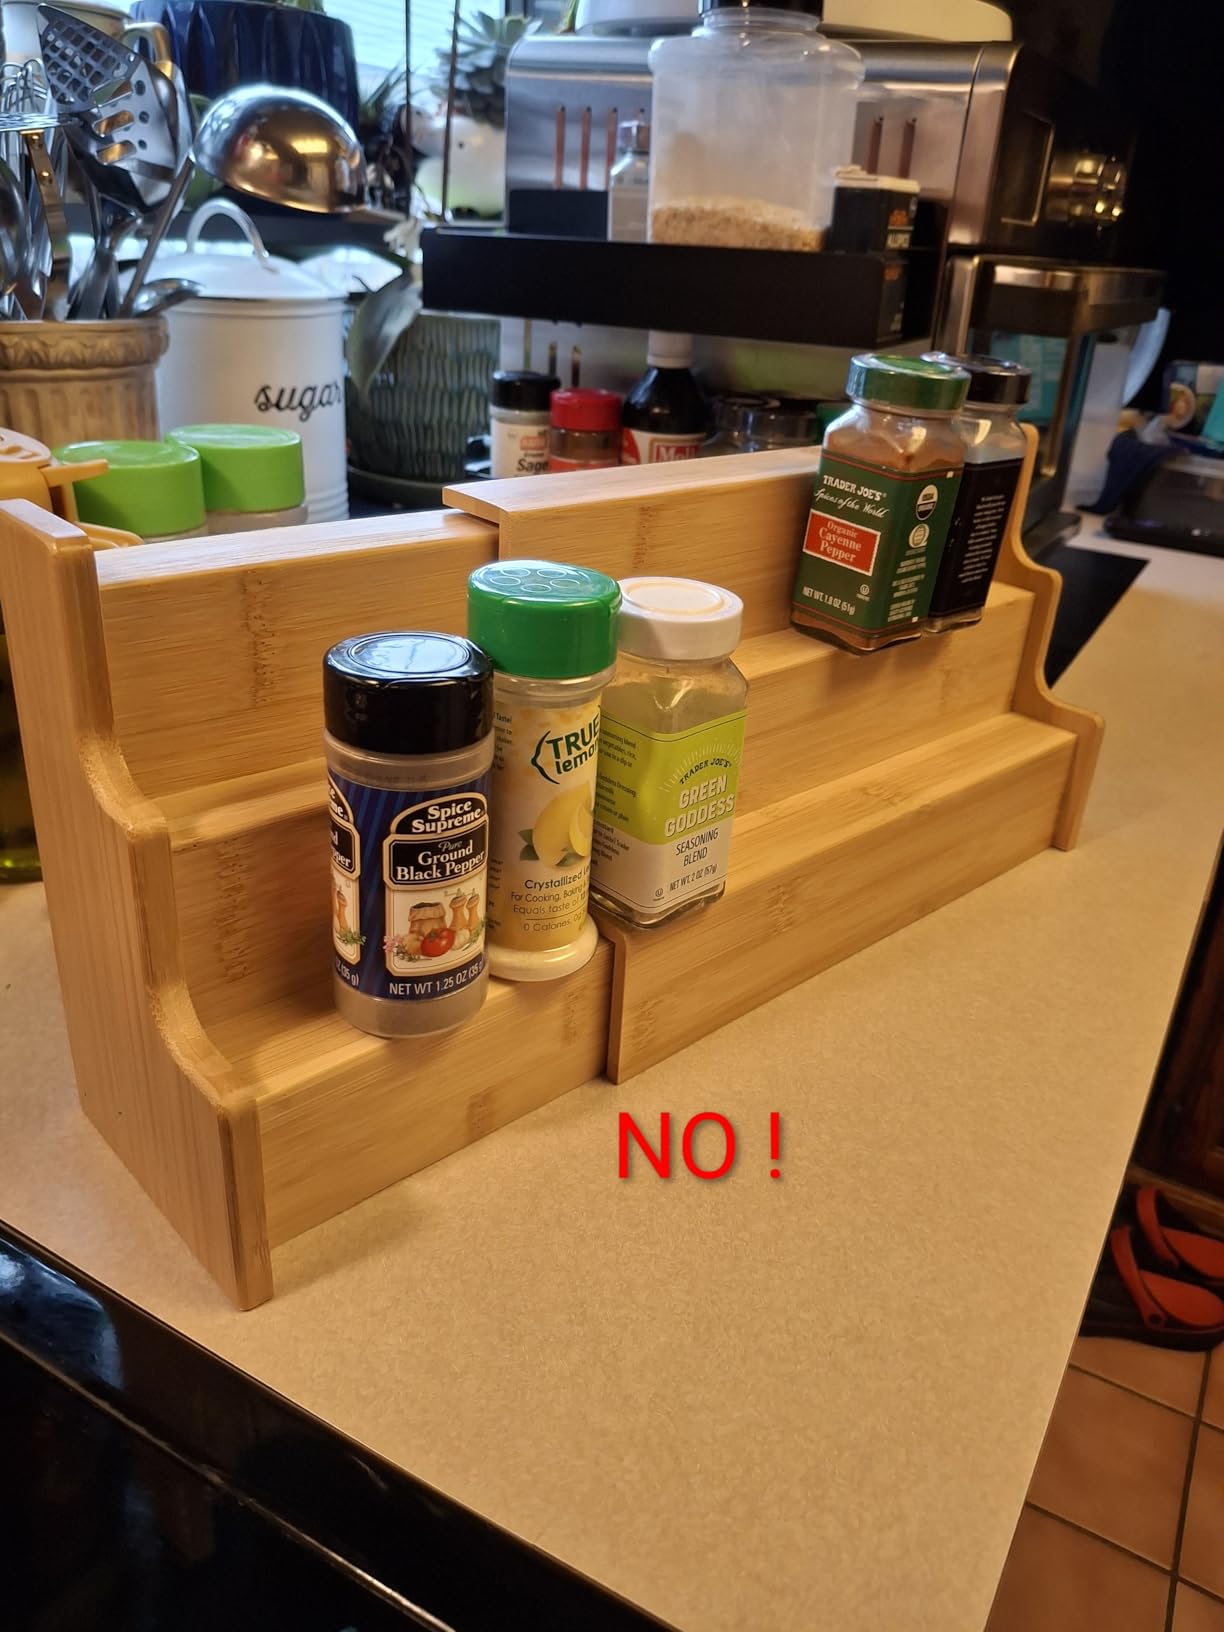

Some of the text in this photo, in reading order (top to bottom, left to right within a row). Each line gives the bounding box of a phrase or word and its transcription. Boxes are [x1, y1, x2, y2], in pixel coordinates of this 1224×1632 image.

[253, 381, 342, 422] sugar
[823, 474, 882, 502] TRADER JOE'S
[814, 488, 890, 518] Spices of the World
[818, 527, 862, 551] Cayenne
[827, 521, 858, 538] Organic
[820, 540, 856, 562] Pepper
[545, 712, 599, 760] TRUE
[680, 759, 709, 785] TRADER
[680, 774, 728, 810] GREEN
[411, 808, 481, 834] Supreme
[427, 801, 472, 821] Spice
[665, 793, 735, 837] GODDESS
[418, 840, 473, 866] Ground
[438, 841, 463, 852] Pure
[676, 828, 718, 856] SEASONING
[396, 864, 442, 881] Black
[445, 851, 485, 877] Pepper
[683, 846, 708, 867] BLEND
[524, 869, 583, 891] Crystallized
[669, 880, 680, 892] NET
[690, 872, 696, 882] 2
[695, 868, 704, 880] OZ
[511, 891, 524, 901] For
[513, 904, 546, 915] Equals
[548, 901, 571, 913] taste
[389, 983, 412, 995] NET
[414, 982, 433, 994] WT
[436, 975, 454, 991] 1.25
[456, 969, 468, 985] OZ
